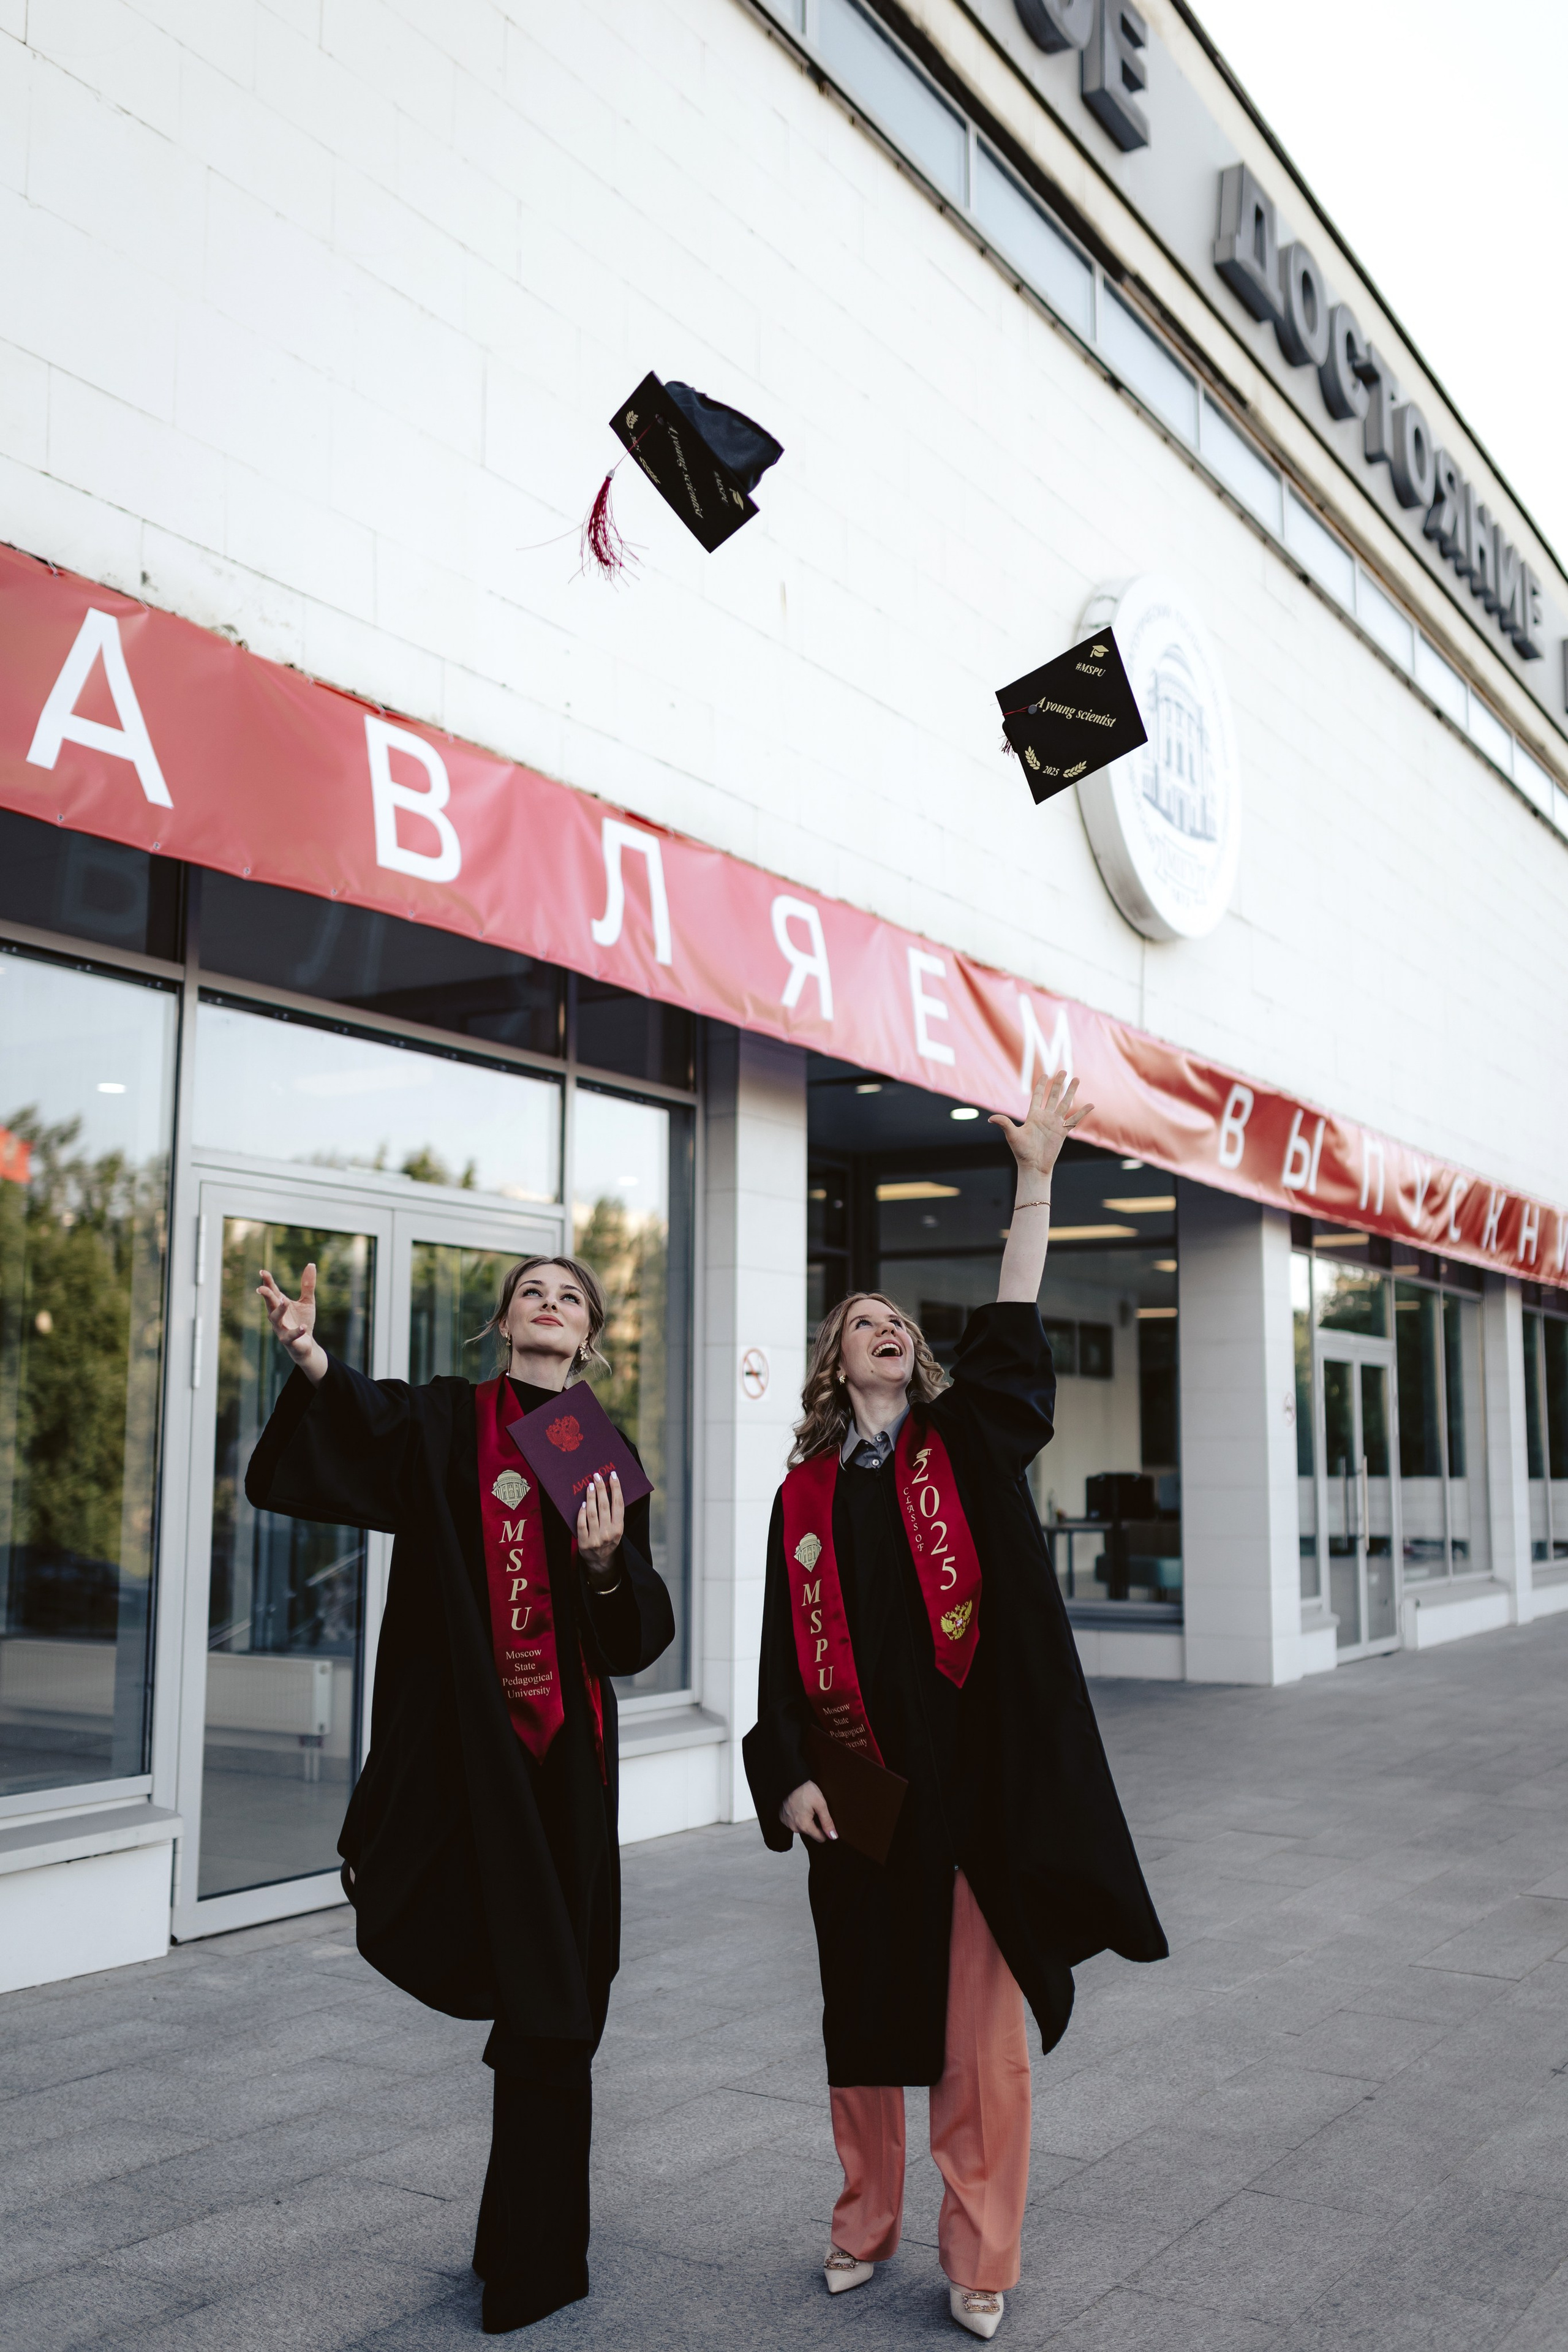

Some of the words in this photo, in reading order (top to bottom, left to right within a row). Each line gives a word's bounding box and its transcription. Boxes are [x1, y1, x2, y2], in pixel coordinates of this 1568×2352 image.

[1213, 162, 1543, 660] ДОСТОЯНИЕ
[668, 431, 687, 471] young
[682, 471, 704, 519] scientist
[1076, 662, 1106, 677] #MSPU
[1035, 696, 1046, 708] A
[1042, 702, 1076, 719] young
[1076, 709, 1116, 728] scientist
[1042, 766, 1060, 776] 2025
[26, 606, 1074, 1098] АВЛЯЕМ
[571, 1462, 616, 1496] ДИПОМ
[903, 1487, 918, 1531] CLASS
[915, 1534, 924, 1551] OF
[911, 1455, 957, 1591] 2025
[499, 1519, 532, 1630] MSPU
[801, 1579, 834, 1691] MSPU
[506, 1649, 541, 1660] Moscow
[502, 1671, 553, 1686] Pedagogical
[514, 1662, 536, 1672] State
[507, 1686, 551, 1698] University
[823, 1703, 850, 1715] Moscow
[829, 1724, 865, 1738] Pedagogical
[833, 1717, 850, 1726] State
